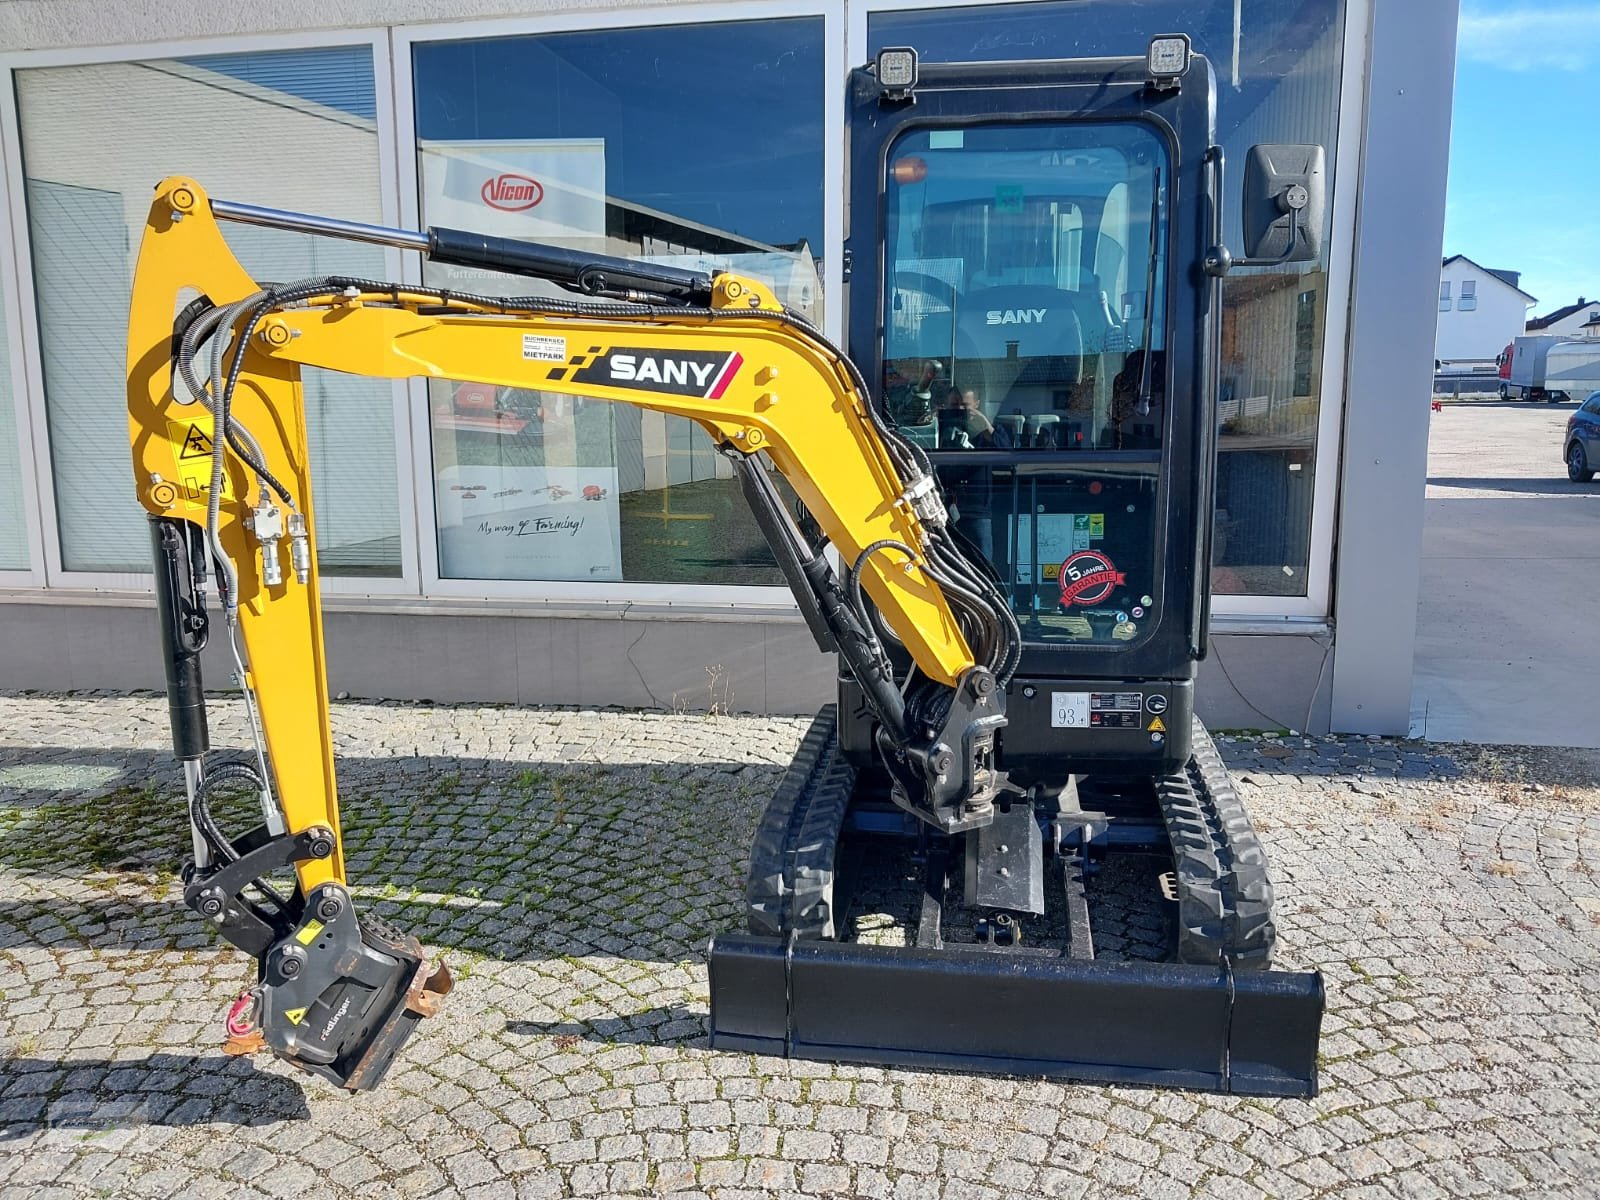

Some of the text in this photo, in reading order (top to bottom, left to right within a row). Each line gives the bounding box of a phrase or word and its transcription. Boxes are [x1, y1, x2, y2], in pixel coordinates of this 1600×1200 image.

[489, 175, 535, 201] Vicon
[986, 308, 1047, 325] SANY
[523, 351, 565, 360] MIETPARK
[610, 354, 716, 387] SANY
[477, 515, 585, 537] My way of Farming!
[1067, 564, 1105, 581] 5 JAHRE
[1065, 572, 1113, 598] GARANTIE
[1058, 708, 1075, 725] 93
